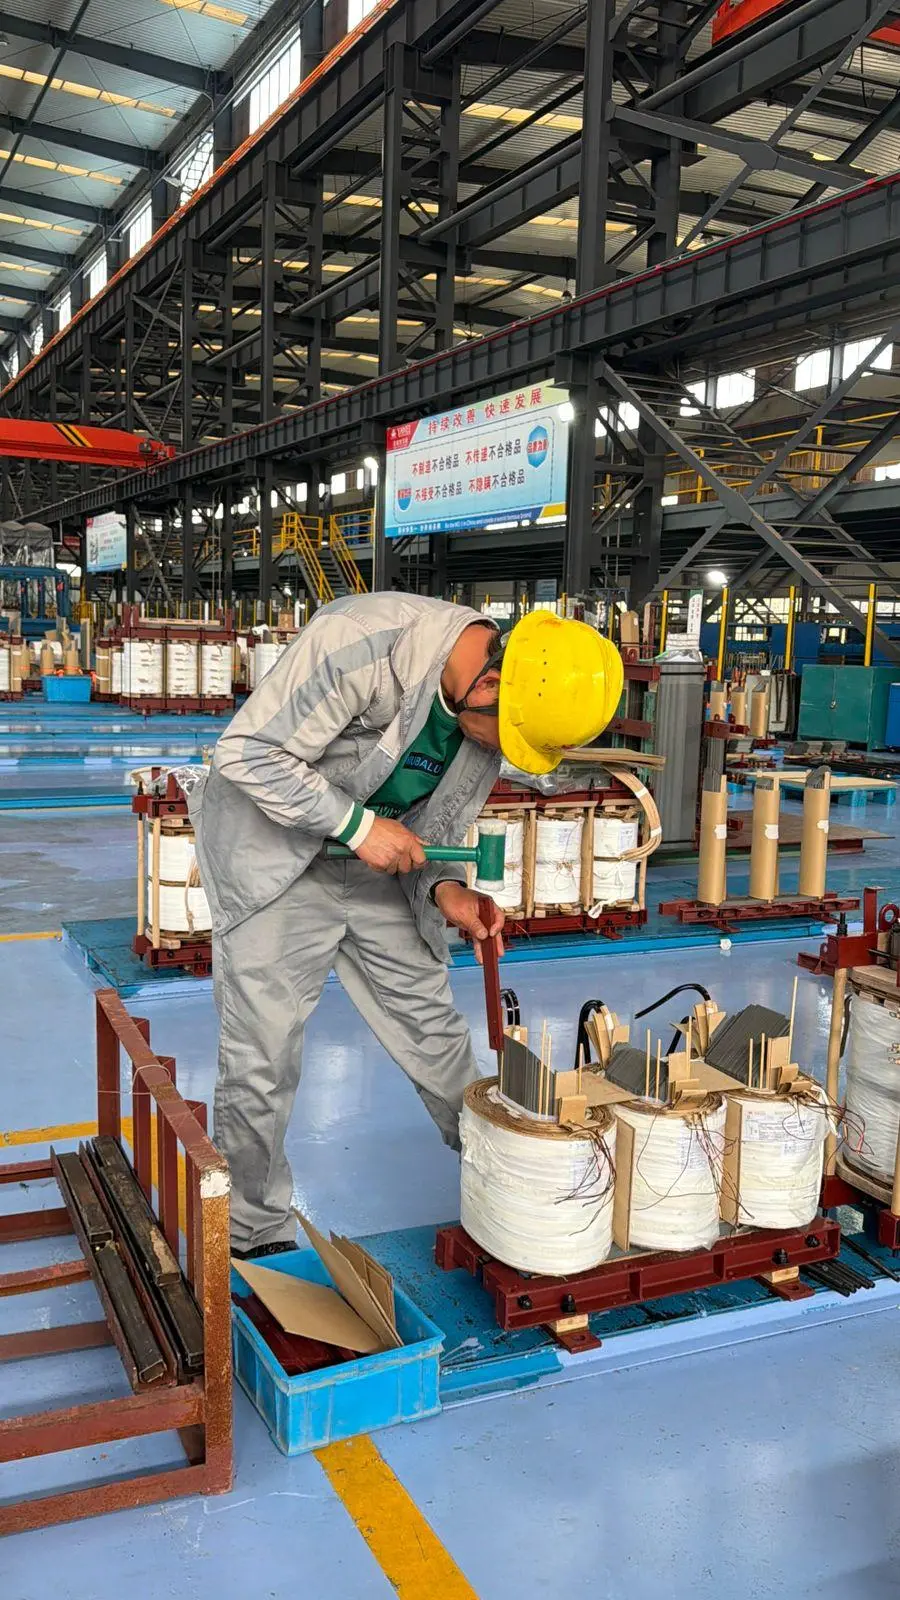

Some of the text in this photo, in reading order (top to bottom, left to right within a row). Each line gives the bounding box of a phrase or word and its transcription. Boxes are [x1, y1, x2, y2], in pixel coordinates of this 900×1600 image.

[428, 388, 542, 435] 持续改善 快速发展
[411, 438, 522, 476] 不制造不合格品 不传递不合格品
[414, 481, 462, 502] 不接受不合格品
[468, 468, 525, 493] 不隐瞒不合格品
